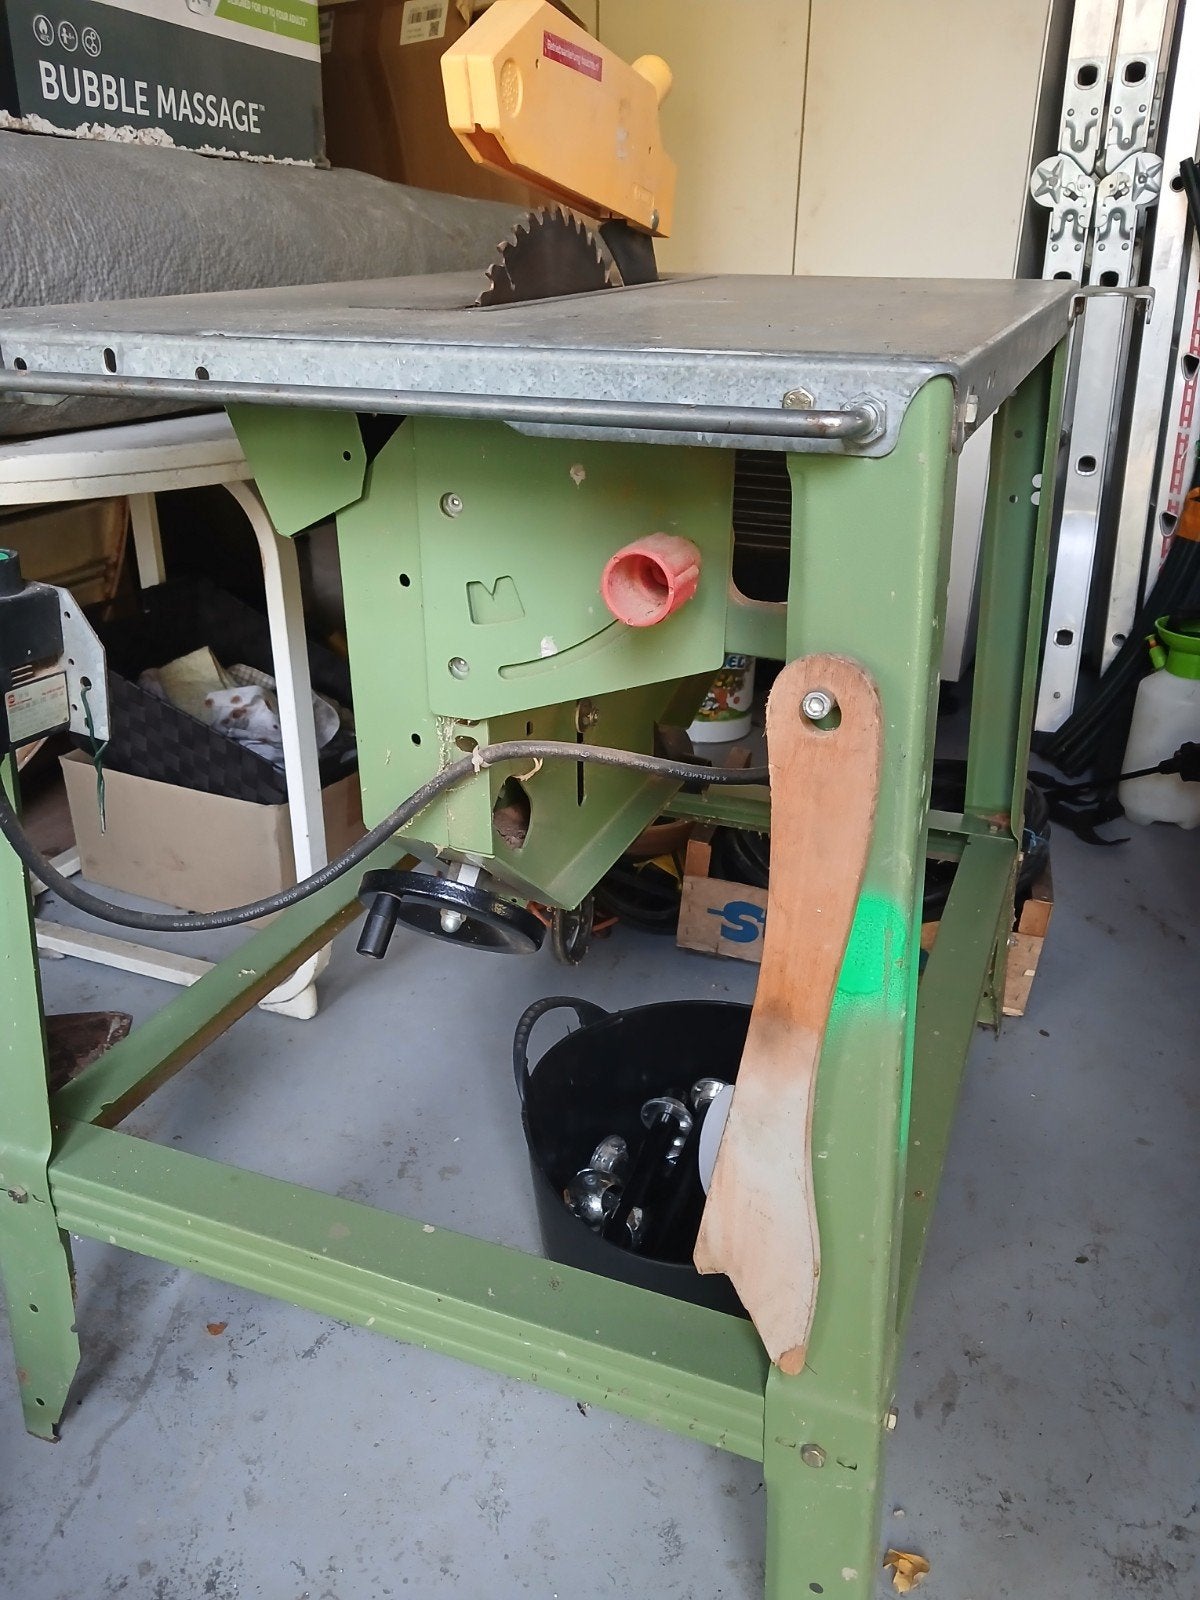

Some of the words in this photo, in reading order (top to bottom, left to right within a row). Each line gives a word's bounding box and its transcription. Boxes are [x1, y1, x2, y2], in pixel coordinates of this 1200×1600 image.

[38, 60, 150, 116] BUBBLE
[675, 769, 720, 781] KABELMETAL
[311, 858, 351, 885] KABELMETAL
